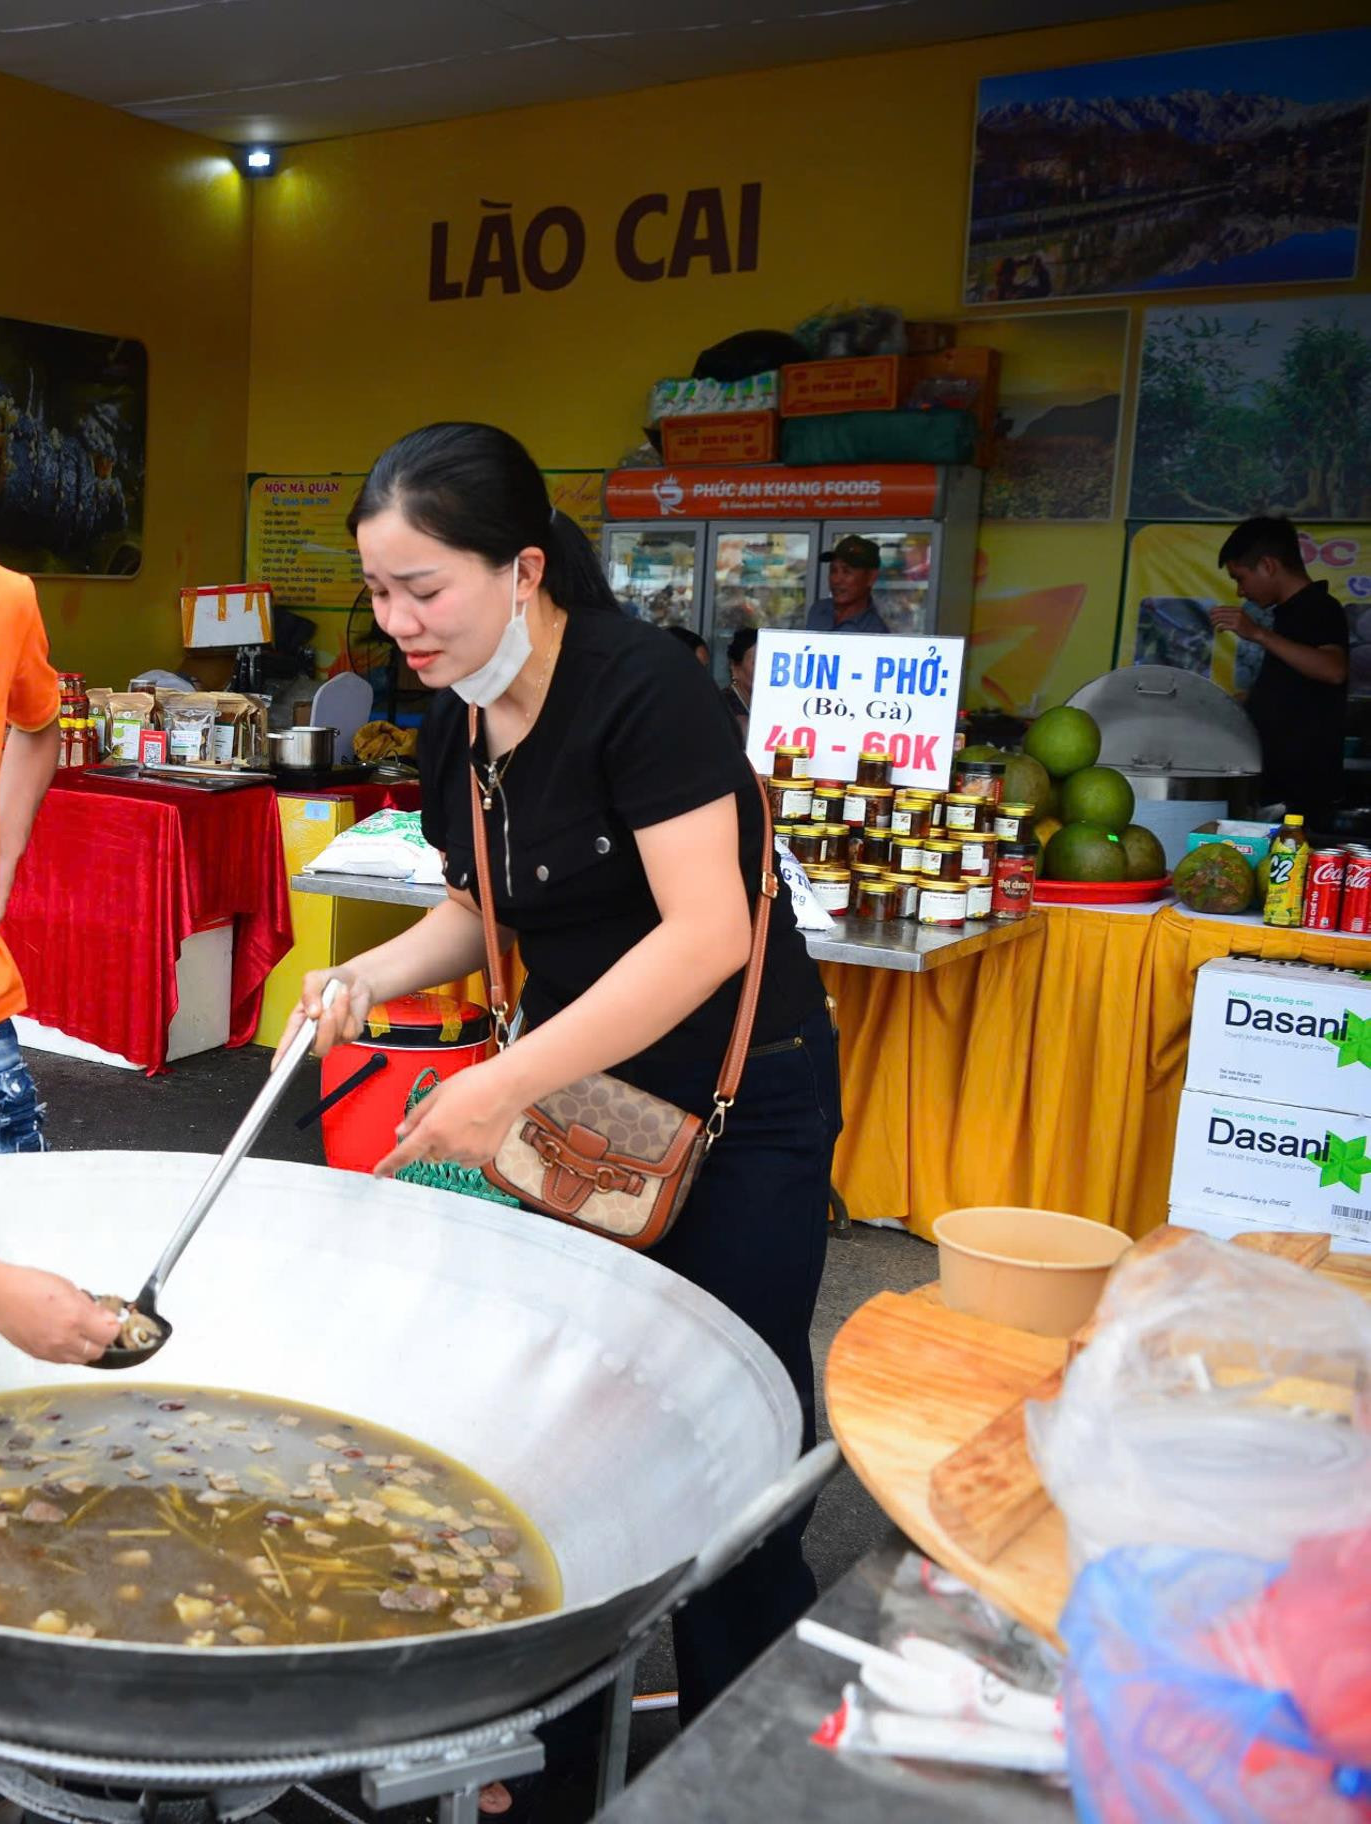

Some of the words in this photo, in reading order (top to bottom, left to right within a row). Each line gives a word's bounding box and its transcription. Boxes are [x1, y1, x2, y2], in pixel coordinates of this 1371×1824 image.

[429, 198, 586, 303] LÀO
[615, 182, 762, 283] CAI
[692, 481, 736, 498] PHÚC
[738, 483, 762, 497] AN
[764, 481, 821, 497] KHANG
[824, 480, 881, 496] FOODS
[769, 645, 841, 690] BÚN
[851, 672, 862, 680] -
[874, 646, 948, 697] PHỞ:
[802, 697, 855, 720] (Bò,
[866, 700, 913, 725] Gà)
[862, 731, 940, 771] 60K
[1270, 855, 1293, 883] C2
[1225, 998, 1350, 1042] Dasani
[1208, 1117, 1332, 1163] Dasani
